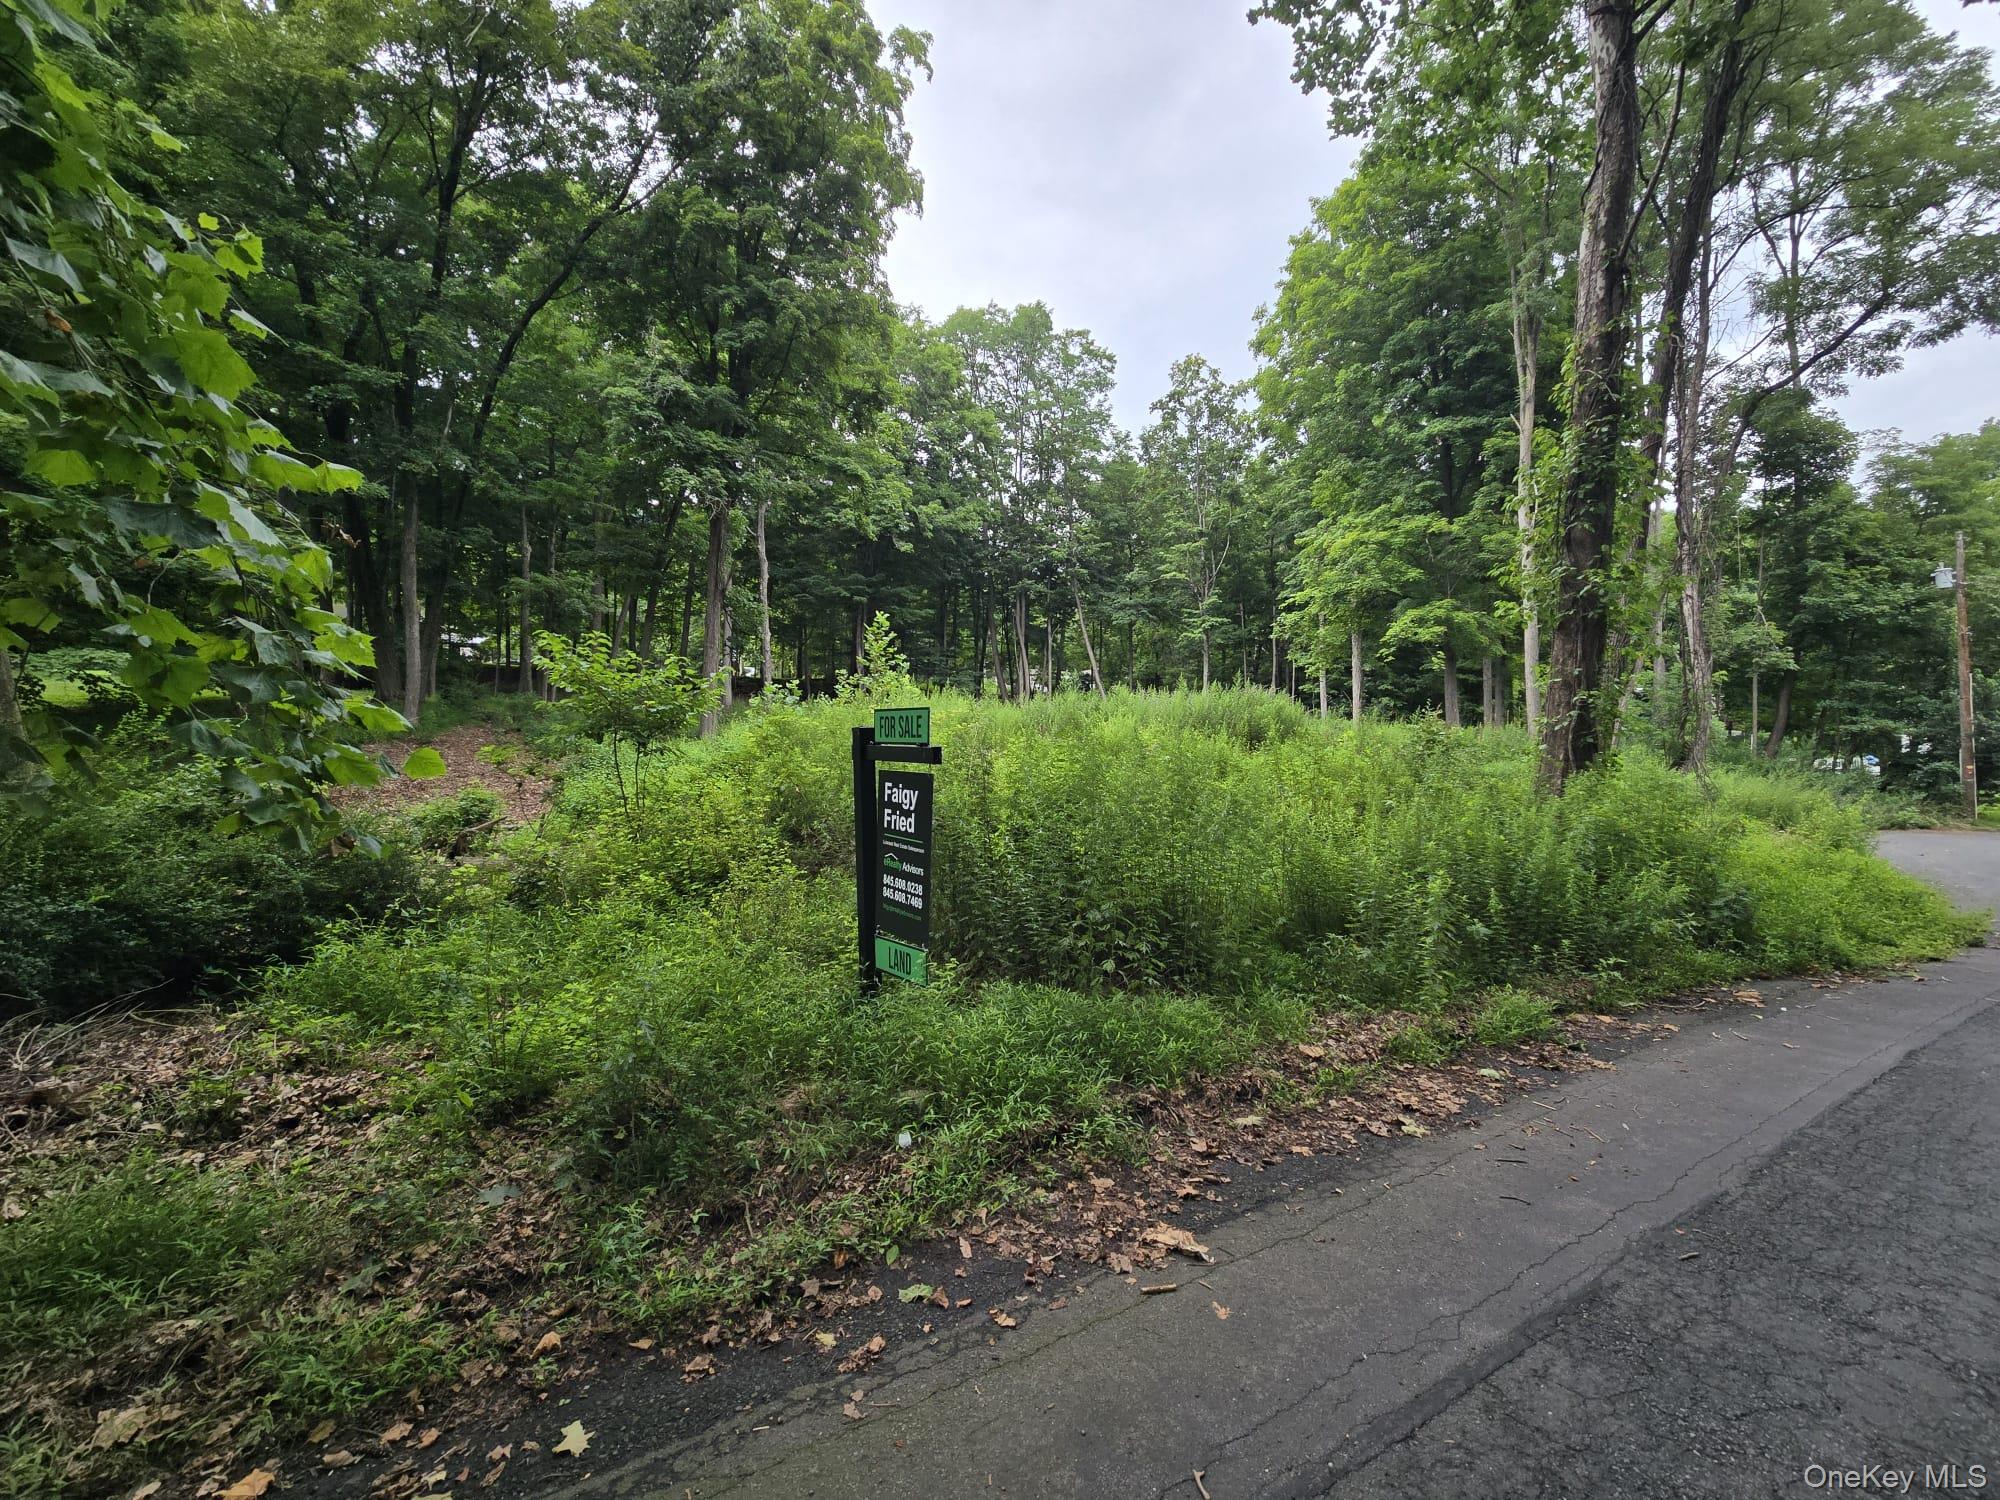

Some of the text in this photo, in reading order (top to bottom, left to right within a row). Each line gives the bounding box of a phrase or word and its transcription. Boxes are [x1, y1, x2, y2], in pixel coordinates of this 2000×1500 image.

[879, 714, 922, 739] FOR SALE
[884, 782, 919, 811] Faigy
[884, 808, 915, 833] Fried
[902, 861, 924, 876] Advisors
[883, 873, 923, 896] 845.608.0238
[882, 886, 923, 909] 845.608.7469
[888, 946, 912, 976] LAND
